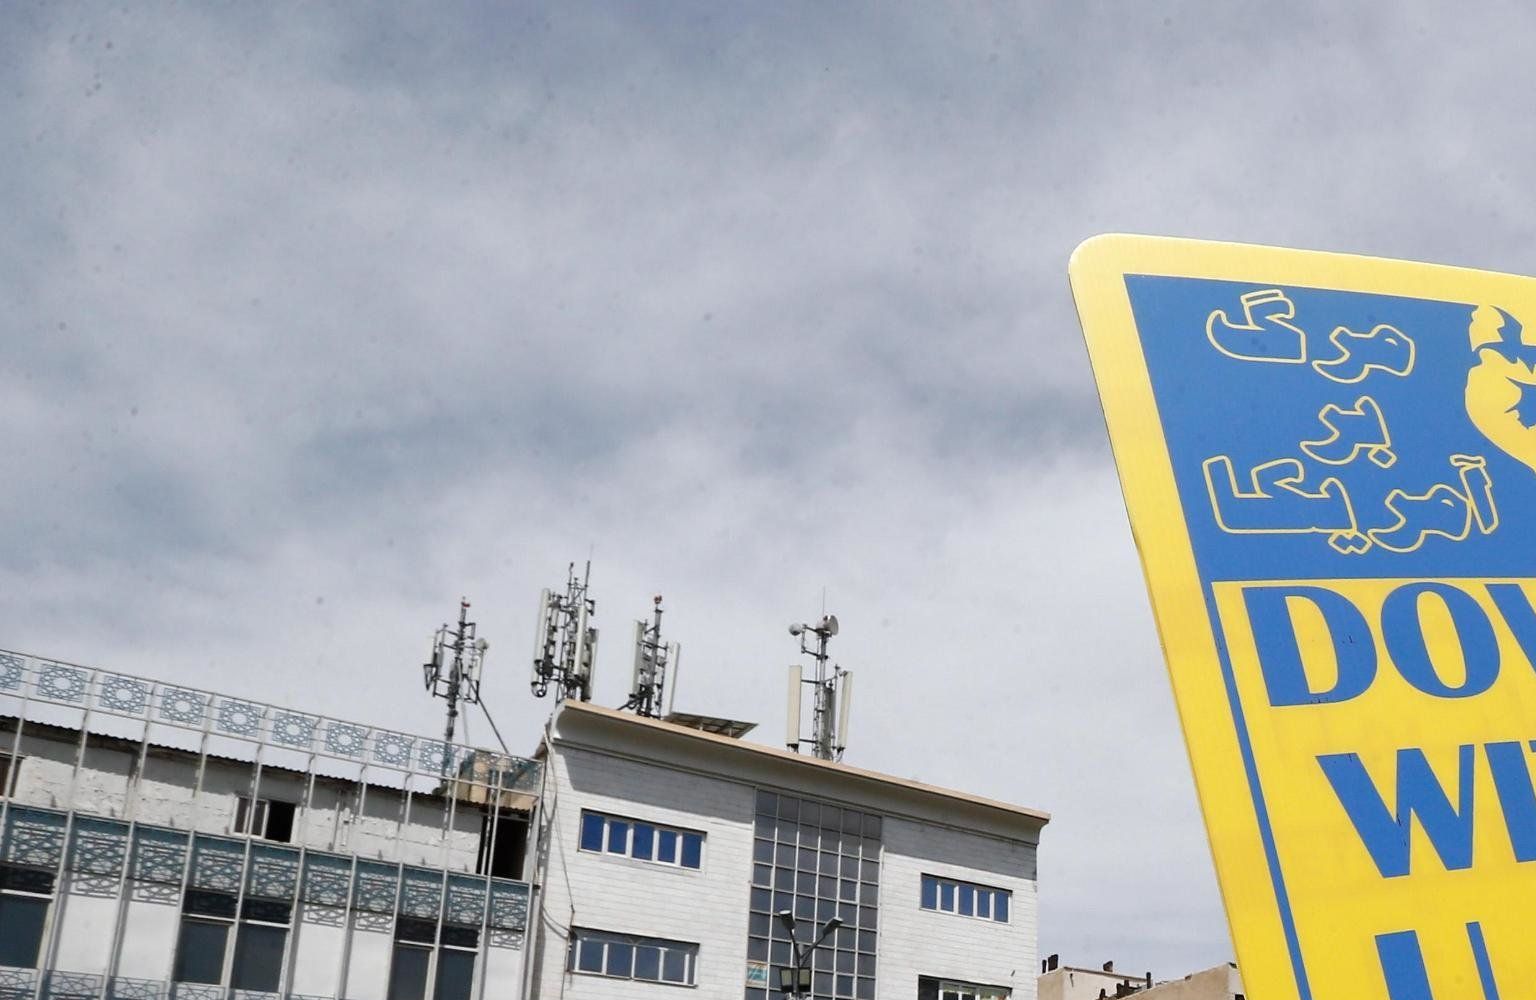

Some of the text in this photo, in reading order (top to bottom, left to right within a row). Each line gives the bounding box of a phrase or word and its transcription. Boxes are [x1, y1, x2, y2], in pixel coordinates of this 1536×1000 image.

[1205, 289, 1416, 383] مرگ
[1300, 395, 1397, 468] بر
[1202, 454, 1499, 554] آمریکا
